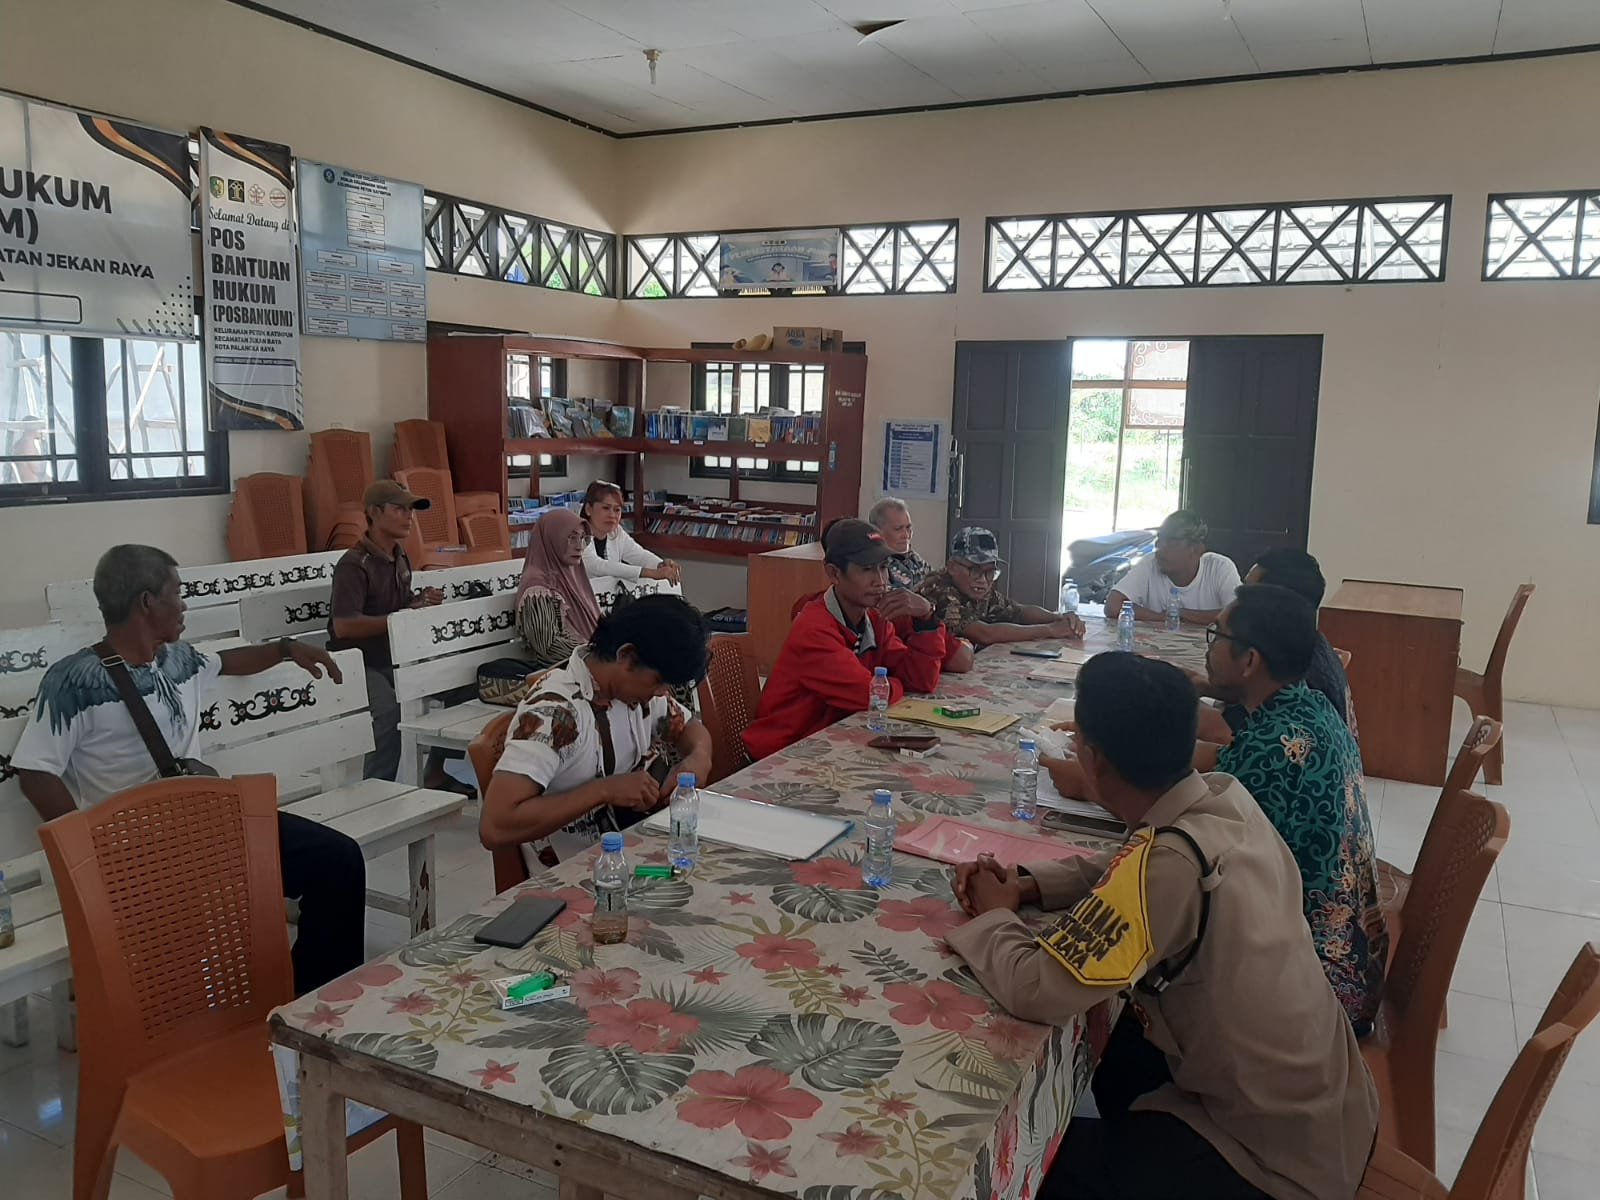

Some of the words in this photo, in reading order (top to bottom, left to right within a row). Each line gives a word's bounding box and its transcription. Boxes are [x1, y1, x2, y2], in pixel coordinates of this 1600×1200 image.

[208, 206, 245, 224] Selamat
[246, 212, 279, 232] Datang
[281, 218, 290, 231] di
[210, 227, 245, 250] POS
[46, 253, 105, 273] JEKAN
[109, 261, 154, 280] RAYA
[211, 253, 290, 282] BANTUAN
[212, 279, 276, 305] HUKUM
[213, 305, 293, 327] (POSBANKUM)
[214, 335, 248, 343] KECAMATAN
[1053, 934, 1090, 970] RAYA
